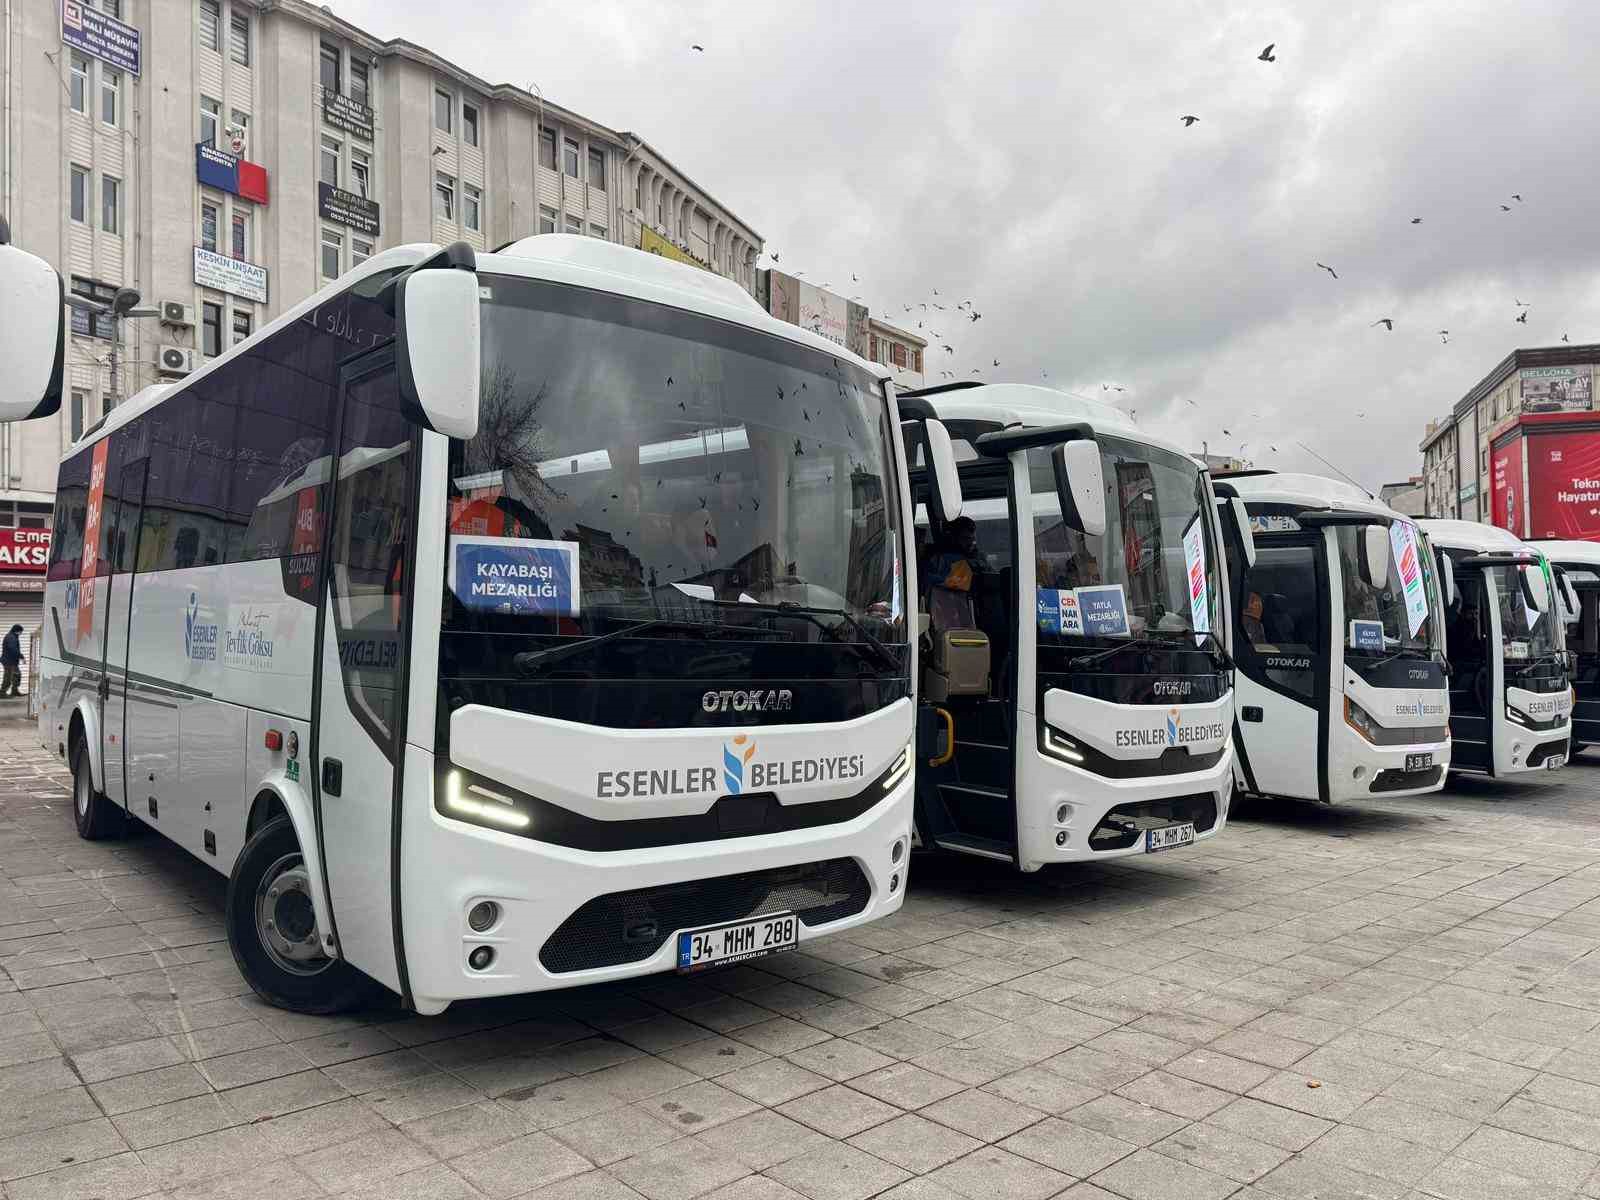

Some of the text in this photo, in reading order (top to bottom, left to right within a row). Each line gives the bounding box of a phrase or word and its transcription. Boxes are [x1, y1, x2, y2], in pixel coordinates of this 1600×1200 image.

[1555, 376, 1589, 391] 36 AY
[477, 563, 553, 582] KAYABAŞI
[471, 582, 558, 599] MEZARLIĞI
[1266, 656, 1311, 668] OTOKAR
[1153, 681, 1192, 696] OTOKAR
[702, 689, 793, 712] OTOKAR
[1116, 723, 1225, 747] ESENLER BELEDİYESİ
[596, 754, 865, 798] ESENLER BELEDİYESİ
[1152, 824, 1192, 847] 34 MHM 267
[692, 919, 793, 961] 34 MHM 288
